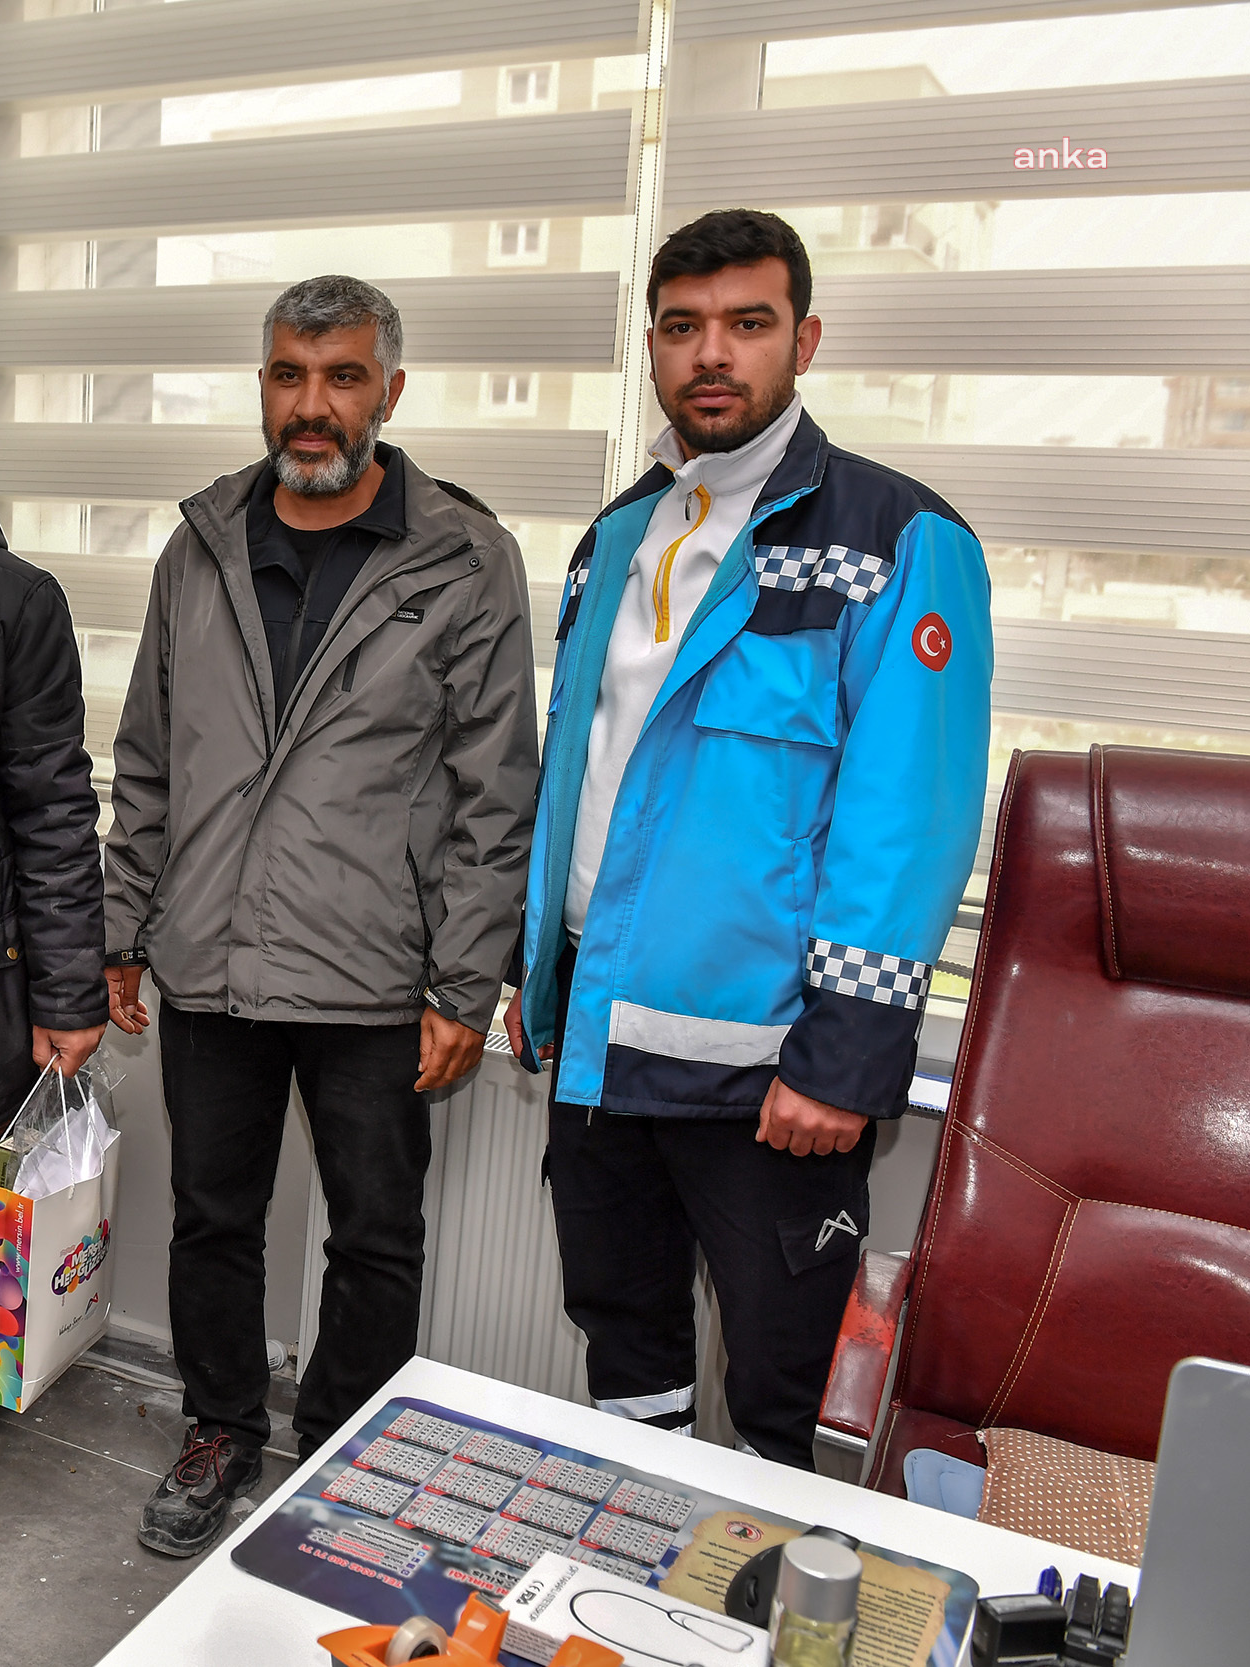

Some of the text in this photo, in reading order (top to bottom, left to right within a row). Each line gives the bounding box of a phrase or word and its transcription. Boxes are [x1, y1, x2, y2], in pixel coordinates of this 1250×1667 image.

[14, 1202, 24, 1272] www.mersin.bel.tr
[54, 1268, 76, 1290] HEP
[298, 1544, 403, 1588] TEL: 0342 360 71 71
